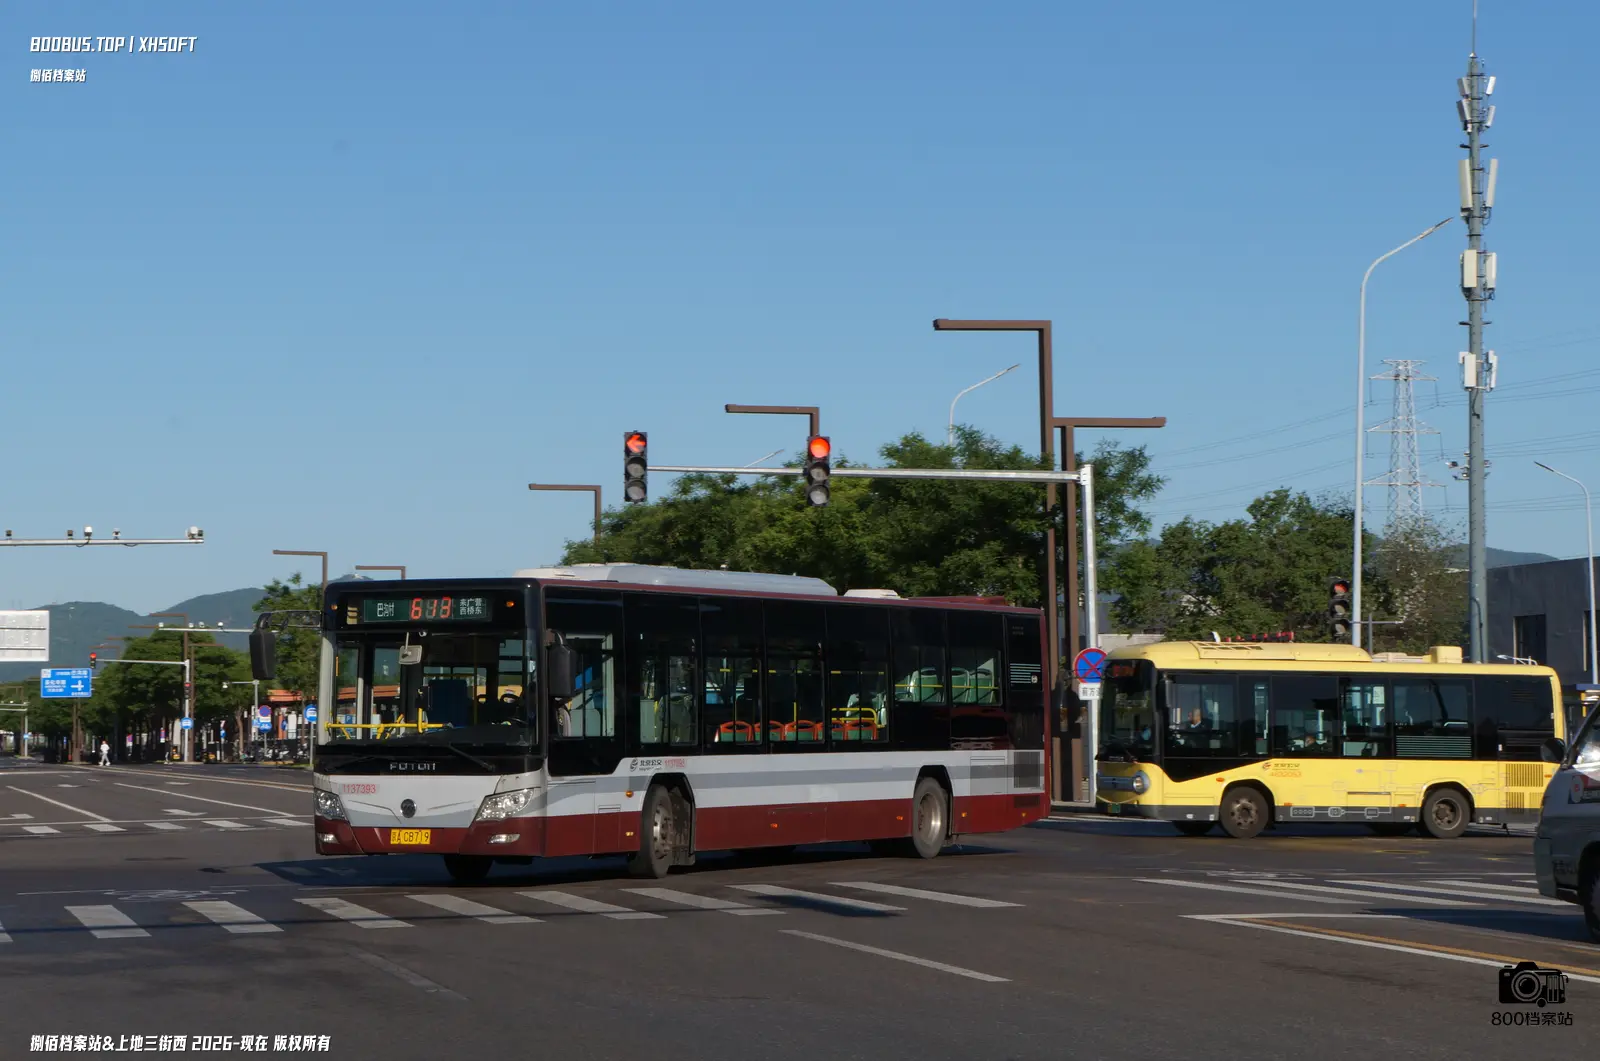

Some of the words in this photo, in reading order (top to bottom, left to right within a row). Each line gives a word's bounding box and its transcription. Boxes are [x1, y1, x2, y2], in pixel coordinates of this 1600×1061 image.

[410, 596, 453, 619] 613
[390, 762, 436, 771] FOTON
[342, 783, 376, 794] 1137393
